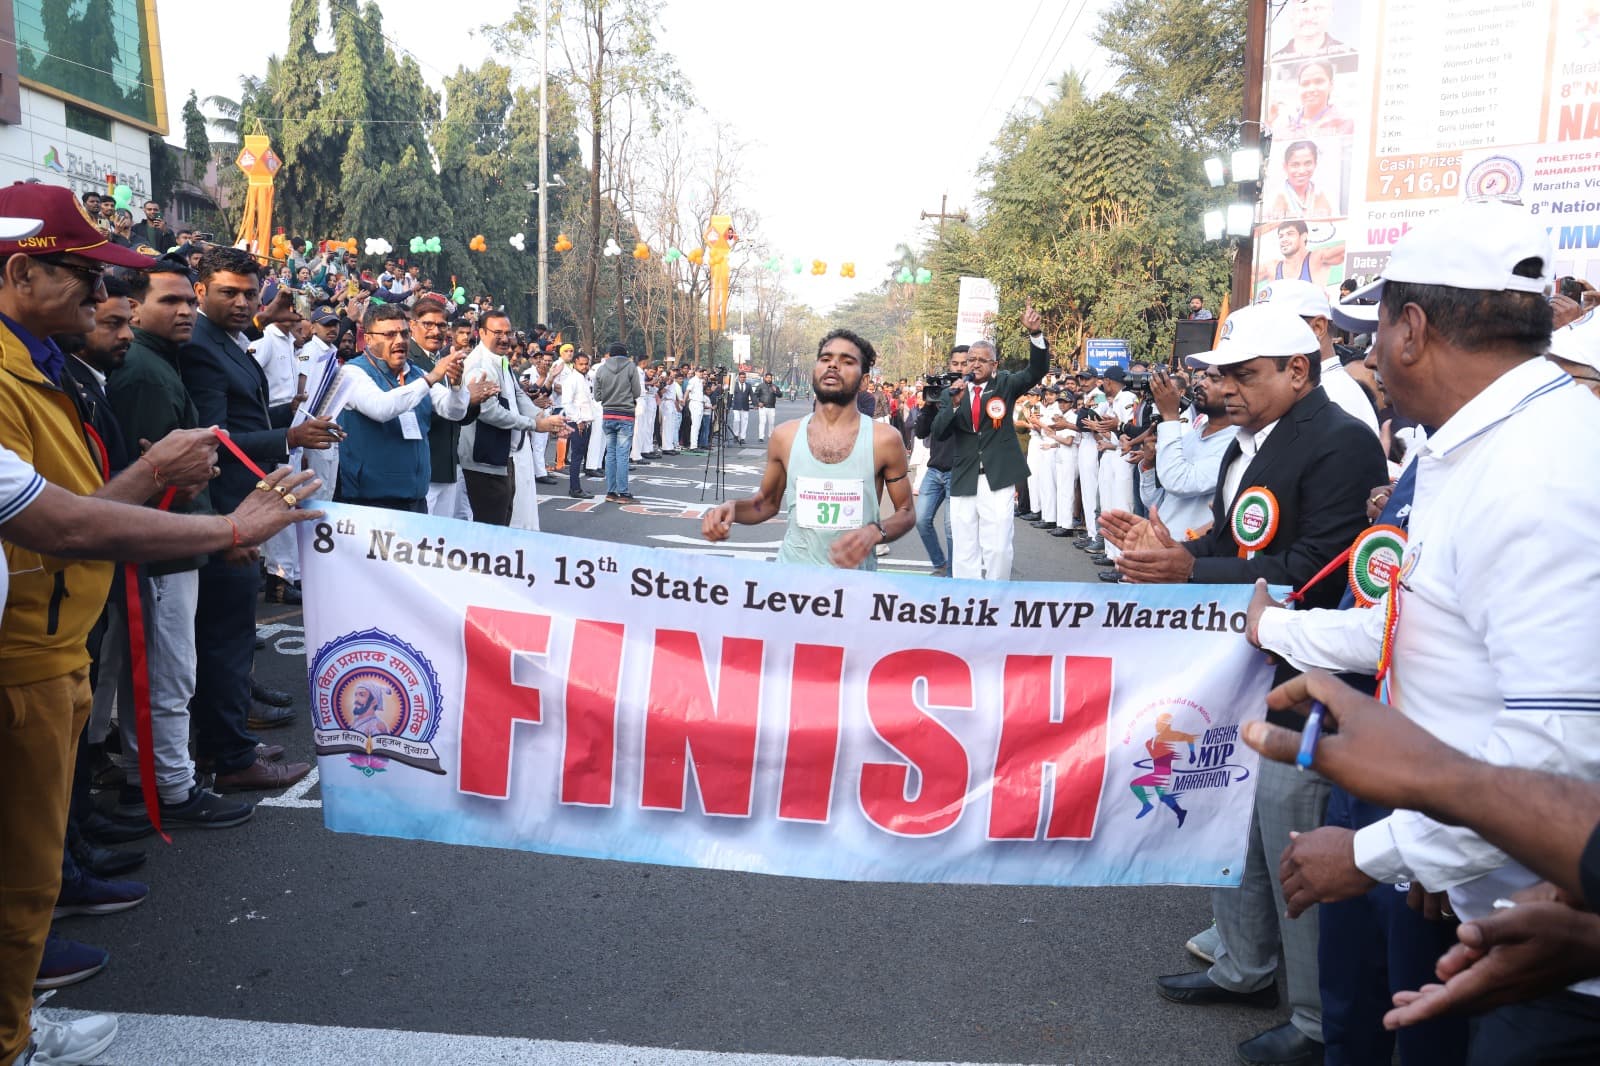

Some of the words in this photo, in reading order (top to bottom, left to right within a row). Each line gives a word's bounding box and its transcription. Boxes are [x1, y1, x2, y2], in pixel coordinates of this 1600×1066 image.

[1461, 89, 1486, 99] Under
[1461, 105, 1486, 115] Under
[1459, 121, 1483, 130] Under
[1378, 159, 1414, 172] Cash
[1418, 155, 1463, 170] Prizes
[1535, 152, 1592, 164] ATHLETICS
[1532, 180, 1581, 192] Maratha
[1368, 210, 1387, 221] For
[1389, 208, 1425, 219] online
[1530, 201, 1549, 215] 8th
[1352, 256, 1378, 269] Date
[817, 502, 840, 525] 37
[313, 519, 356, 554] 8th
[366, 528, 536, 588] National,
[553, 555, 618, 589] 13th
[630, 567, 729, 606] State
[743, 580, 844, 619] Level
[870, 593, 998, 628] Nashik
[1010, 600, 1095, 629] MVP
[1102, 601, 1247, 635] Maratho
[336, 650, 388, 670] प्रसारक
[317, 662, 339, 691] विद्या
[388, 655, 420, 692] समाज,
[319, 692, 332, 726] मराठा
[456, 604, 1114, 843] FINISH
[1202, 724, 1239, 746] NASHIK
[375, 737, 403, 748] बहुजन
[403, 743, 430, 755] सुखाय
[1196, 743, 1235, 768] MVP
[1172, 770, 1232, 793] MARATHON
